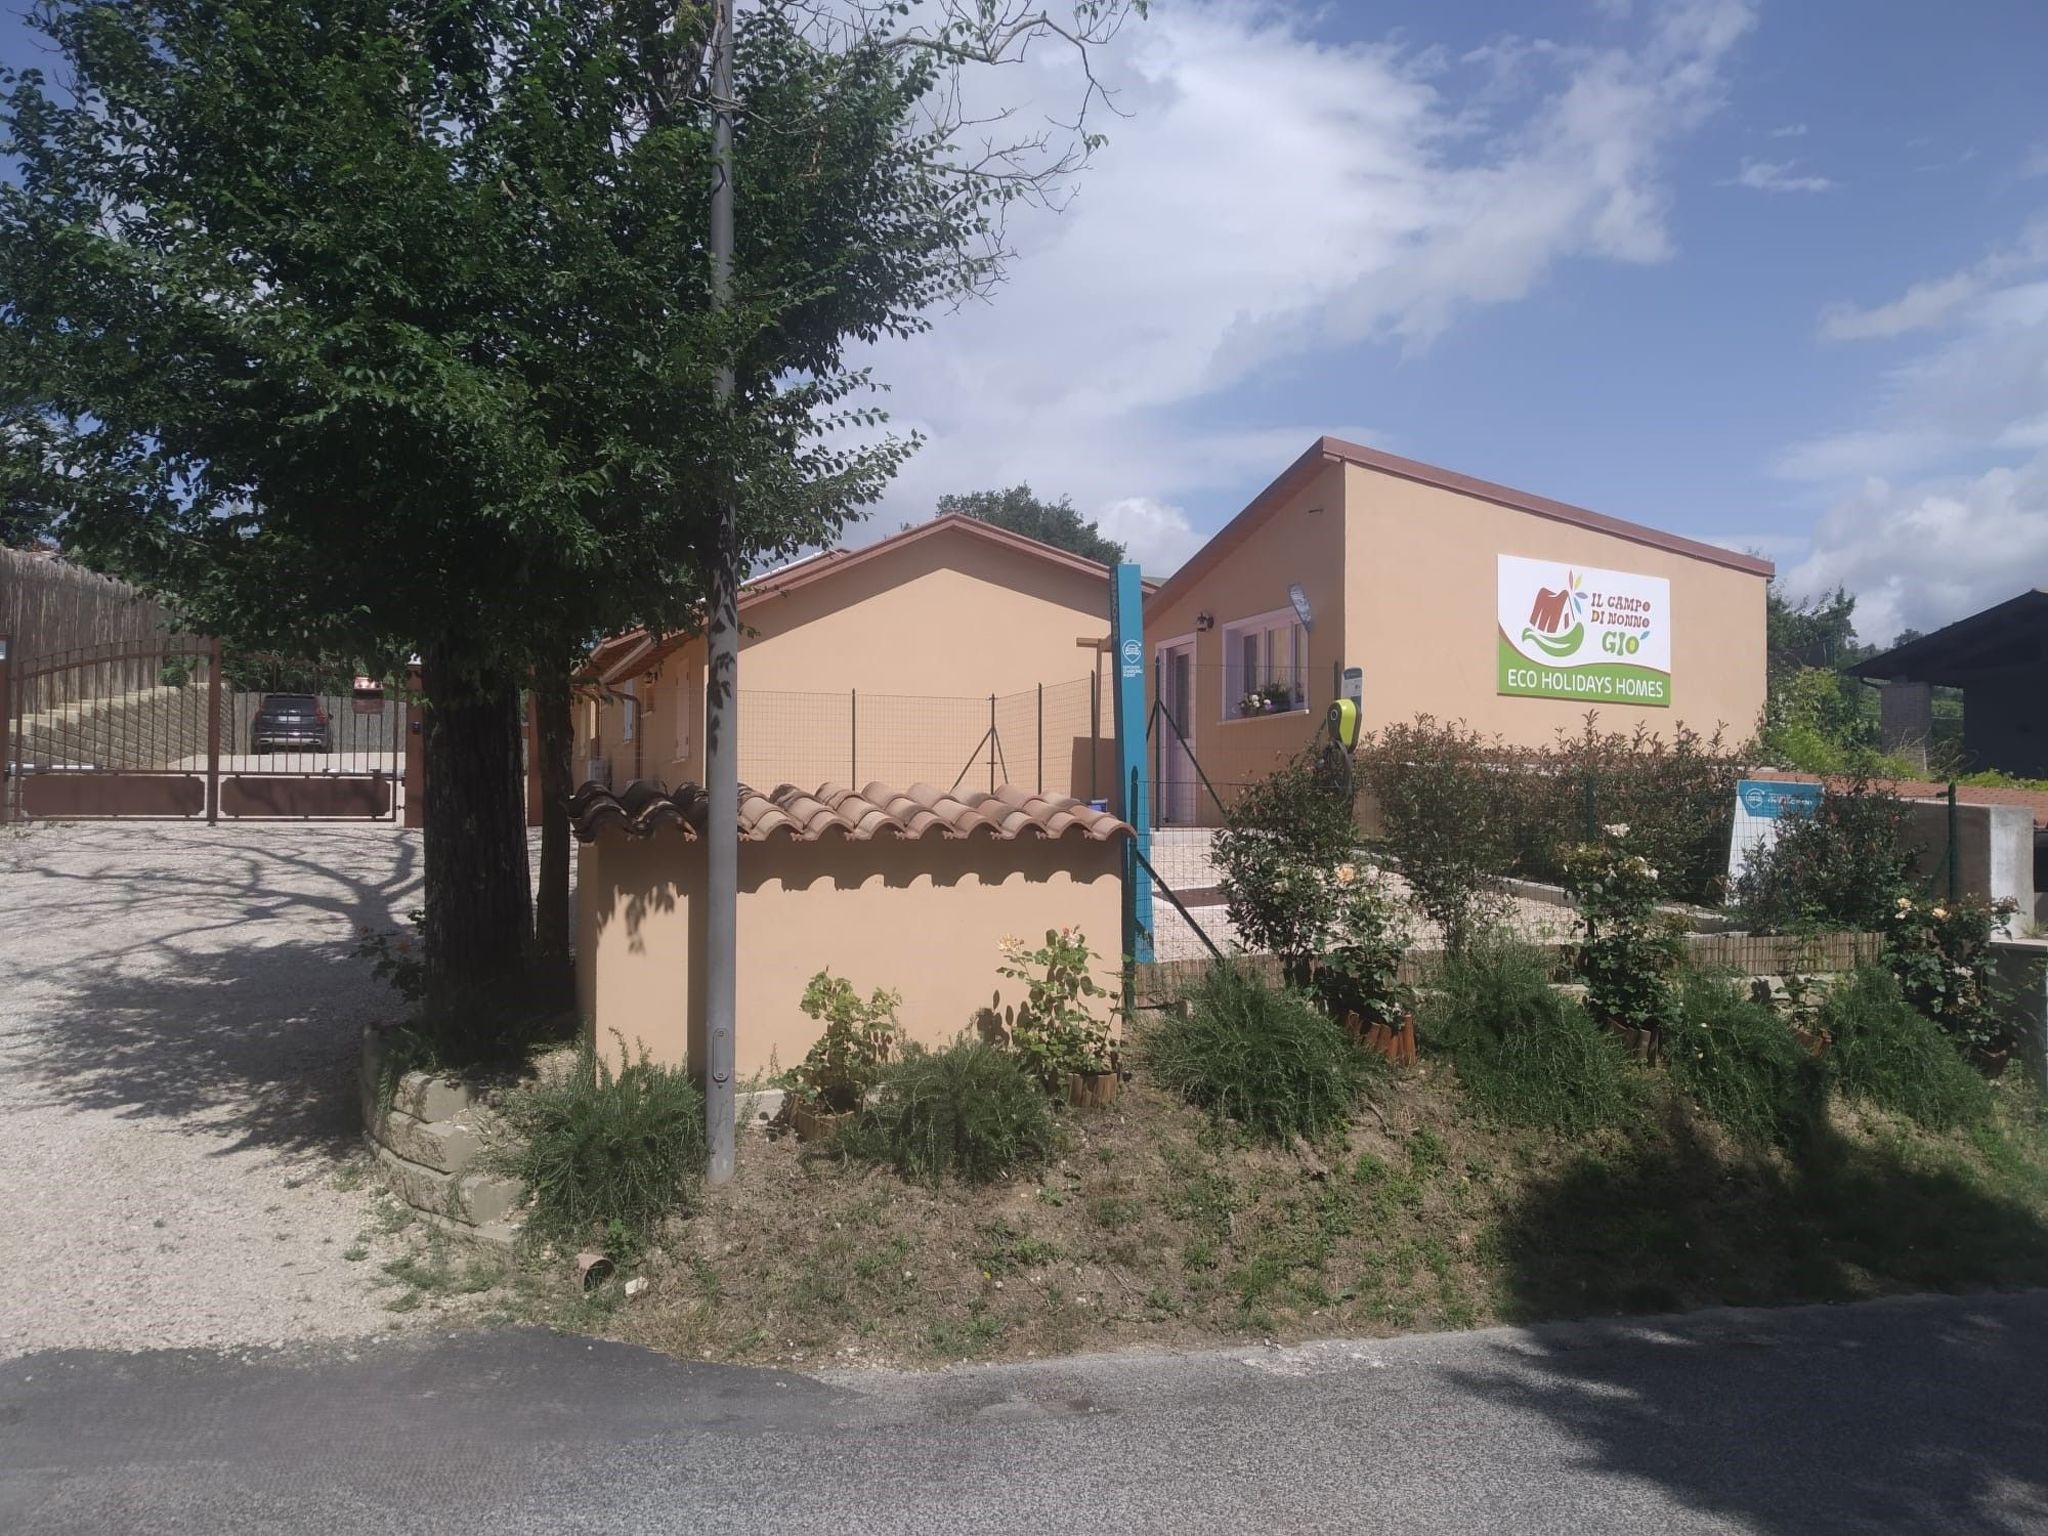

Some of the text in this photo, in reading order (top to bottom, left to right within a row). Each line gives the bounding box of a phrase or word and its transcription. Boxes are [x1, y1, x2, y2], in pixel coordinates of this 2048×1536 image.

[1591, 593, 1651, 612] IL CAMPO
[1591, 609, 1650, 628] DI NONNO
[1507, 668, 1664, 698] ECO HOLIDAYS HOMES
